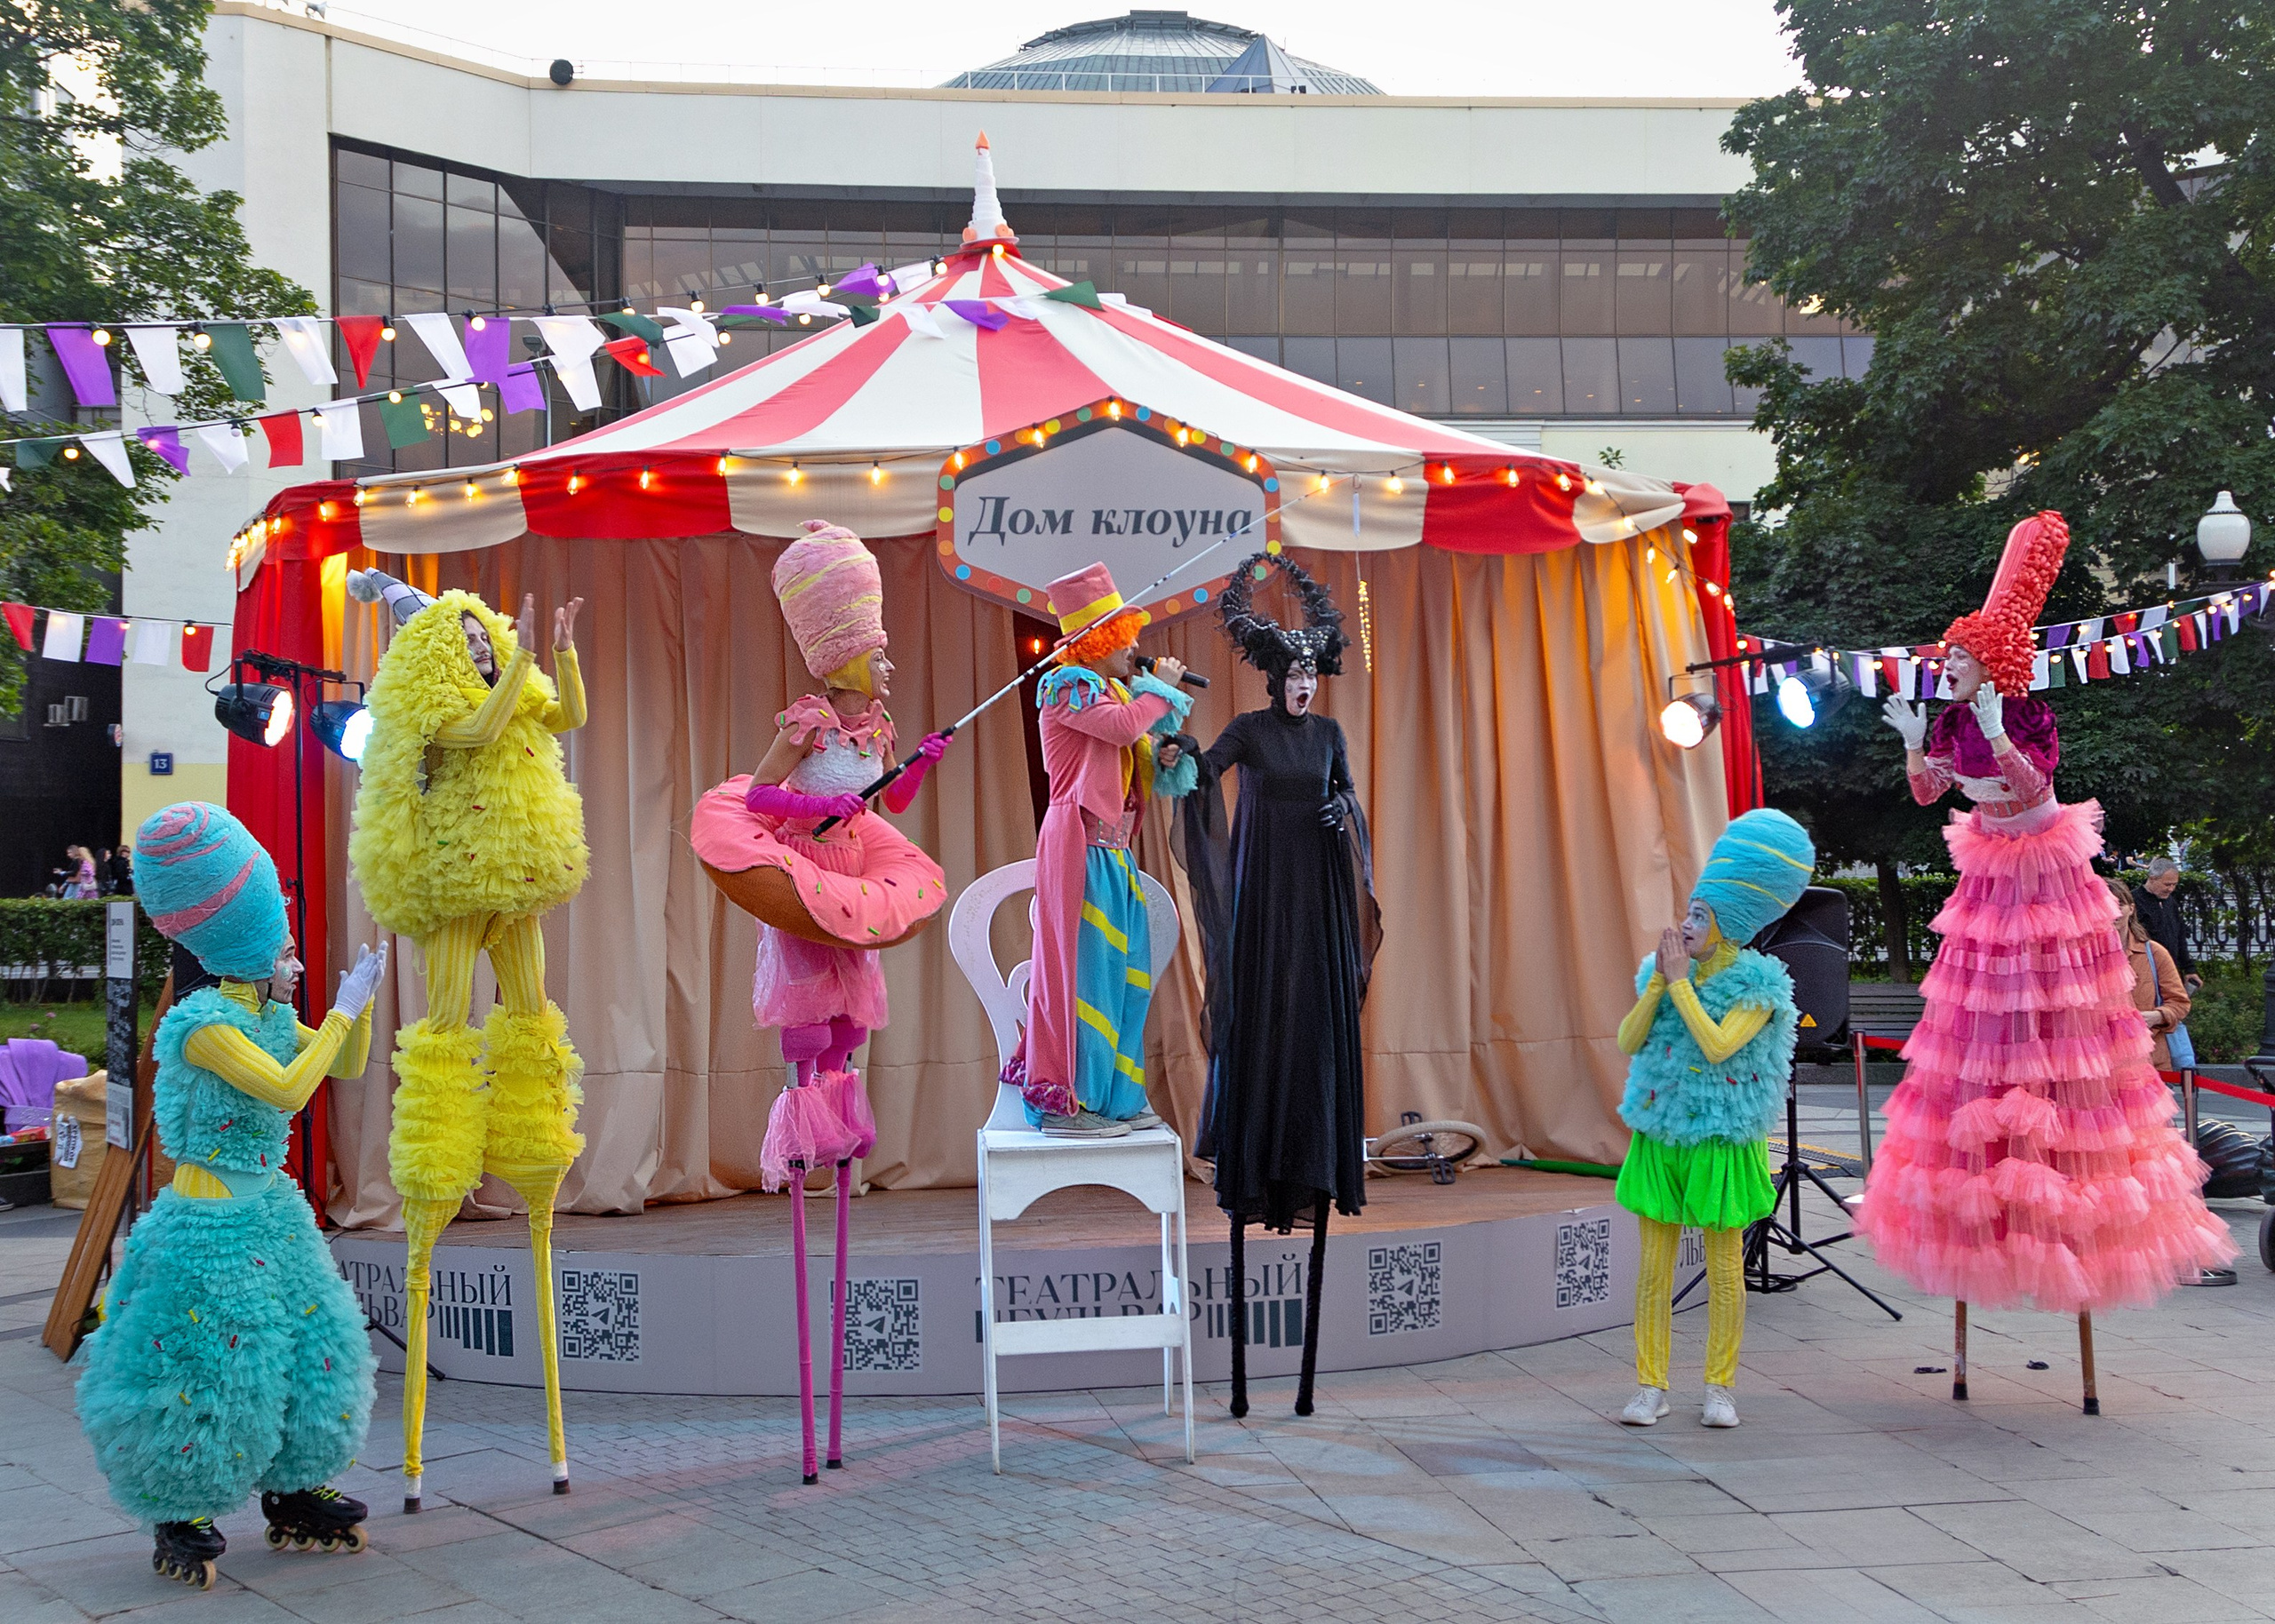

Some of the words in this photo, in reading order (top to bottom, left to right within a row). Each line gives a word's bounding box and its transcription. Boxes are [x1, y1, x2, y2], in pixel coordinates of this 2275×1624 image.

[968, 496, 1074, 546] Дом
[1091, 508, 1253, 548] клоуна
[154, 758, 168, 769] 13
